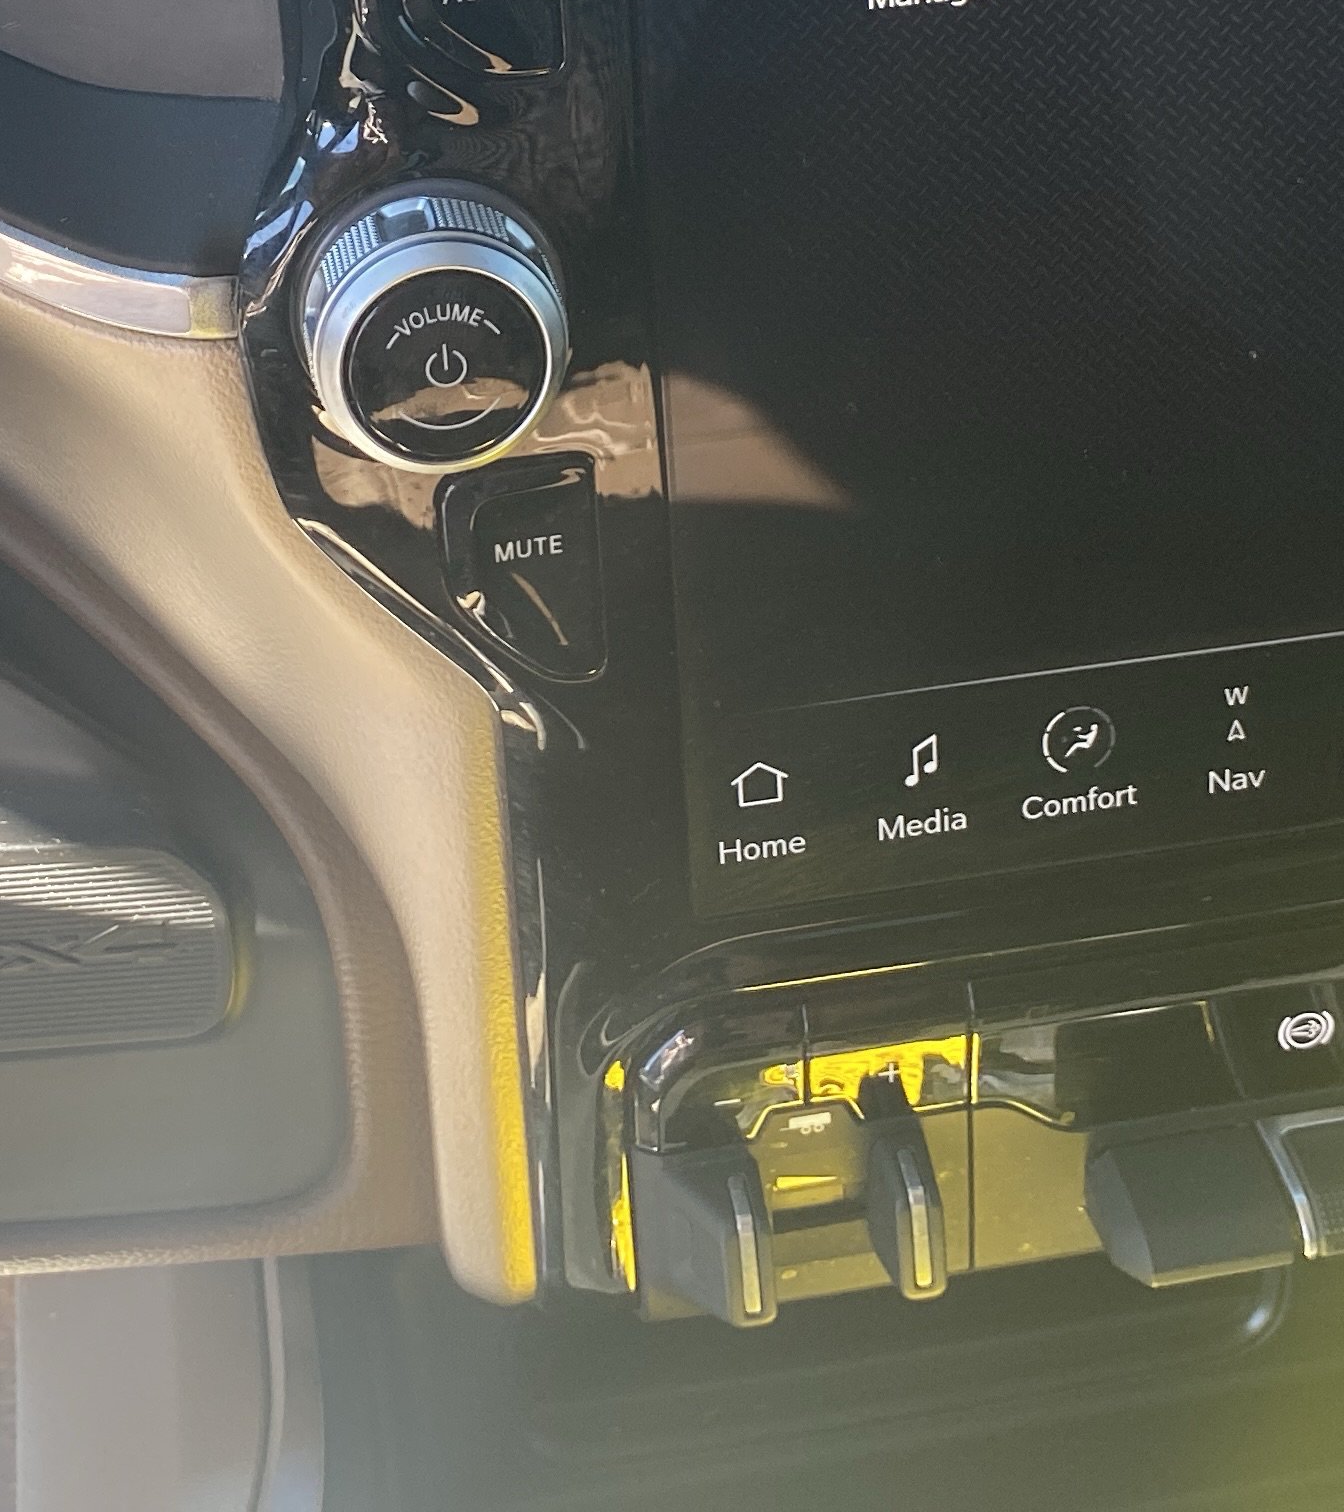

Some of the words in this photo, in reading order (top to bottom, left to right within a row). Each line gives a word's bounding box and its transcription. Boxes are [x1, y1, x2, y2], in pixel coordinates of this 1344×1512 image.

[393, 303, 486, 337] VOLUME
[494, 533, 564, 563] MUTE
[1224, 685, 1250, 706] W
[1207, 769, 1267, 794] Nav
[1021, 784, 1139, 820] Comfort
[876, 808, 969, 842] Media
[718, 835, 807, 865] Home
